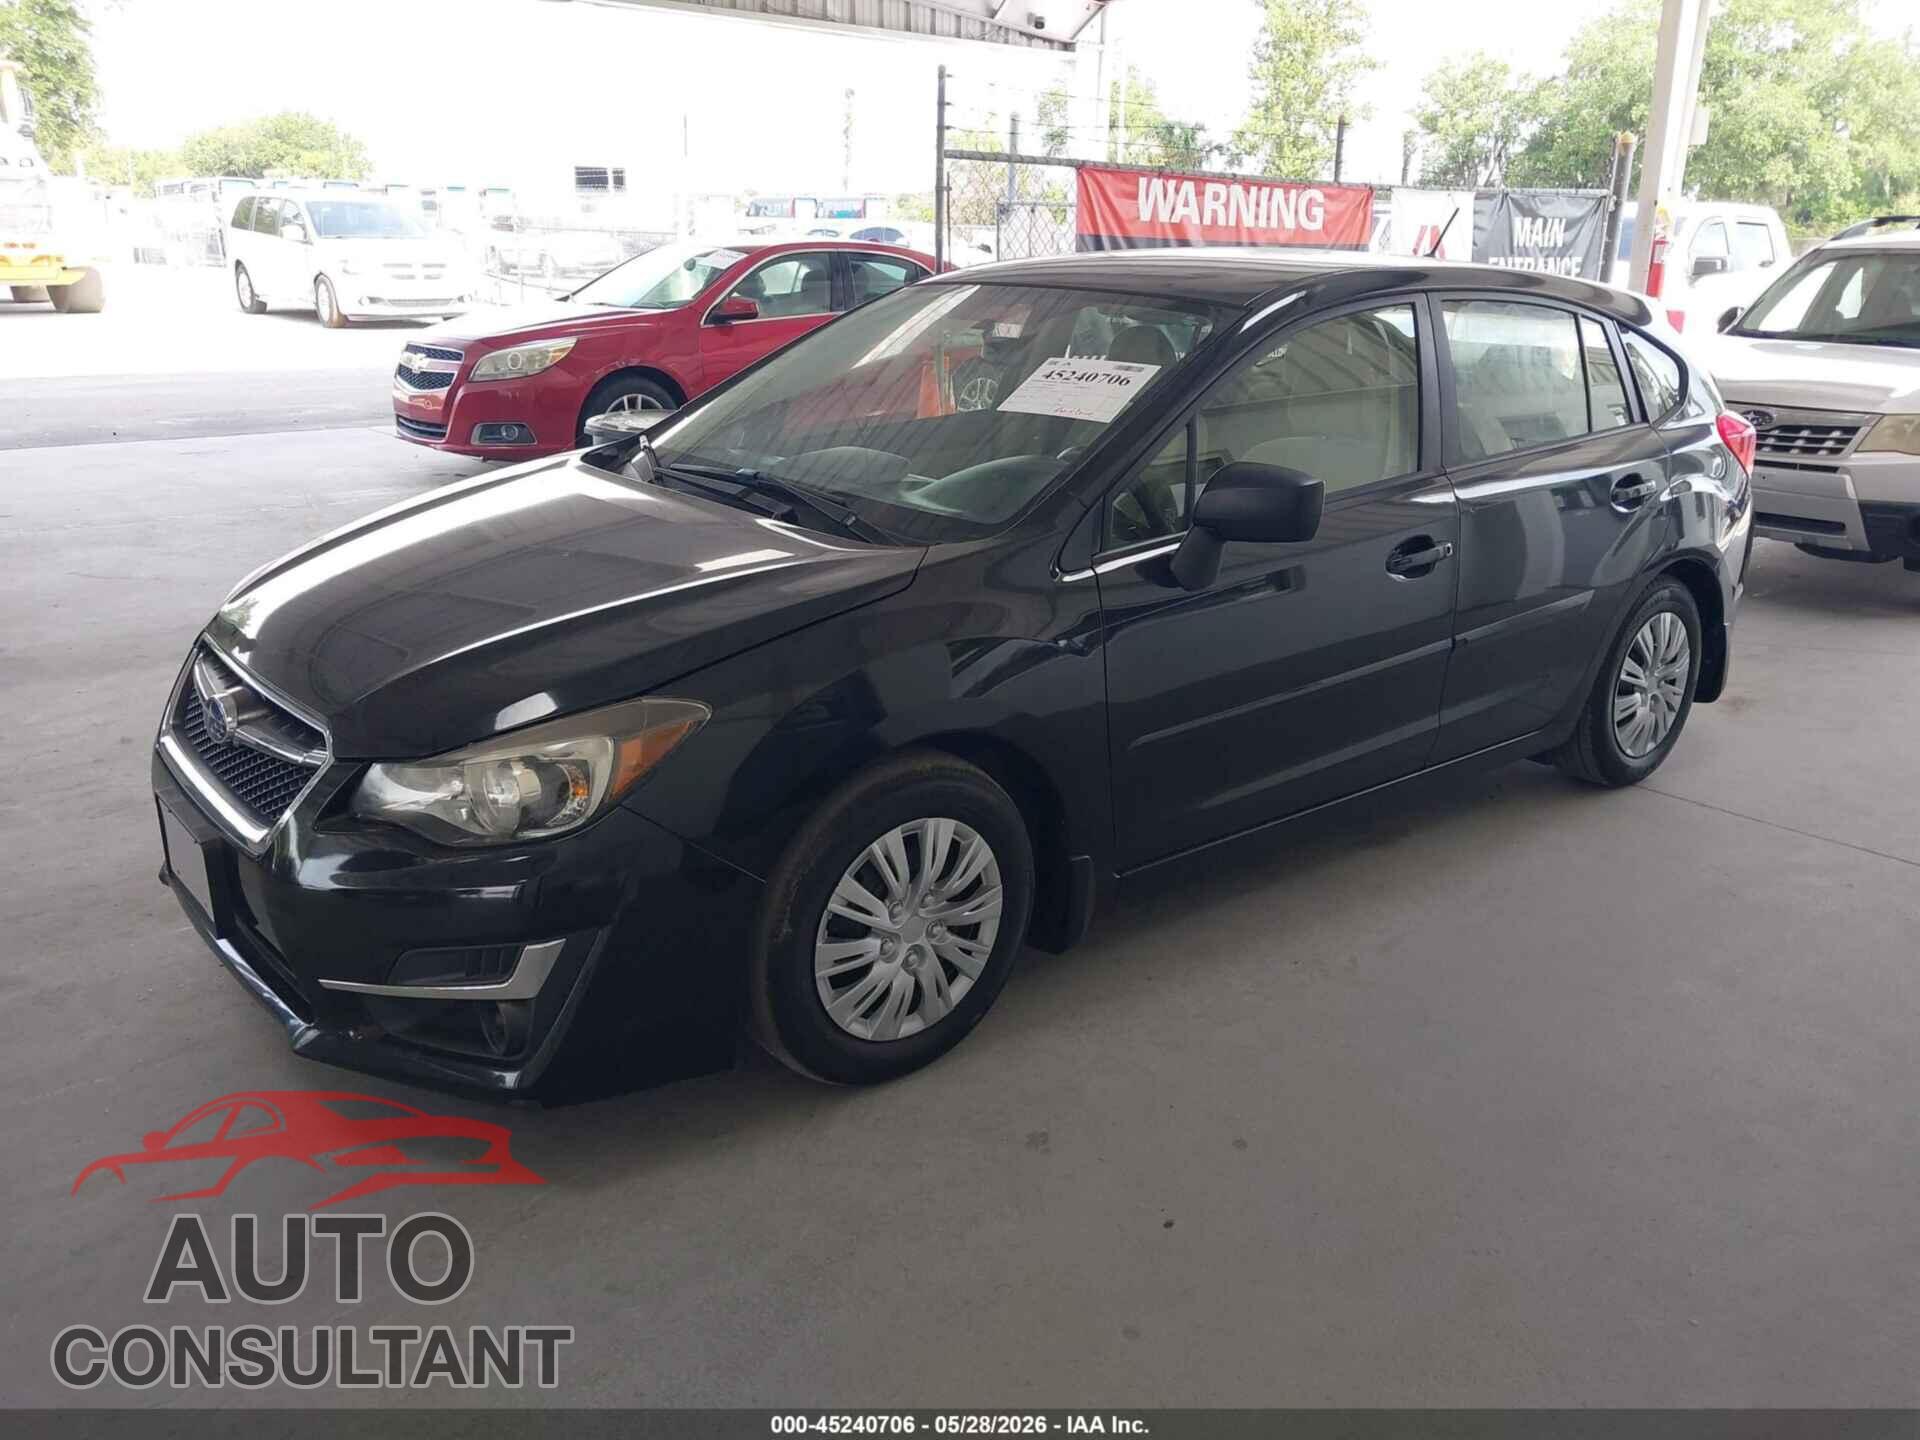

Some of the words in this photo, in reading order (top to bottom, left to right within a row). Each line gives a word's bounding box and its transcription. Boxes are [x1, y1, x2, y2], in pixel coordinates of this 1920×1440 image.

[1138, 176, 1326, 231] WARNING
[1513, 217, 1567, 248] MAIN
[1488, 256, 1584, 278] ANCE
[1042, 369, 1131, 386] 45240706
